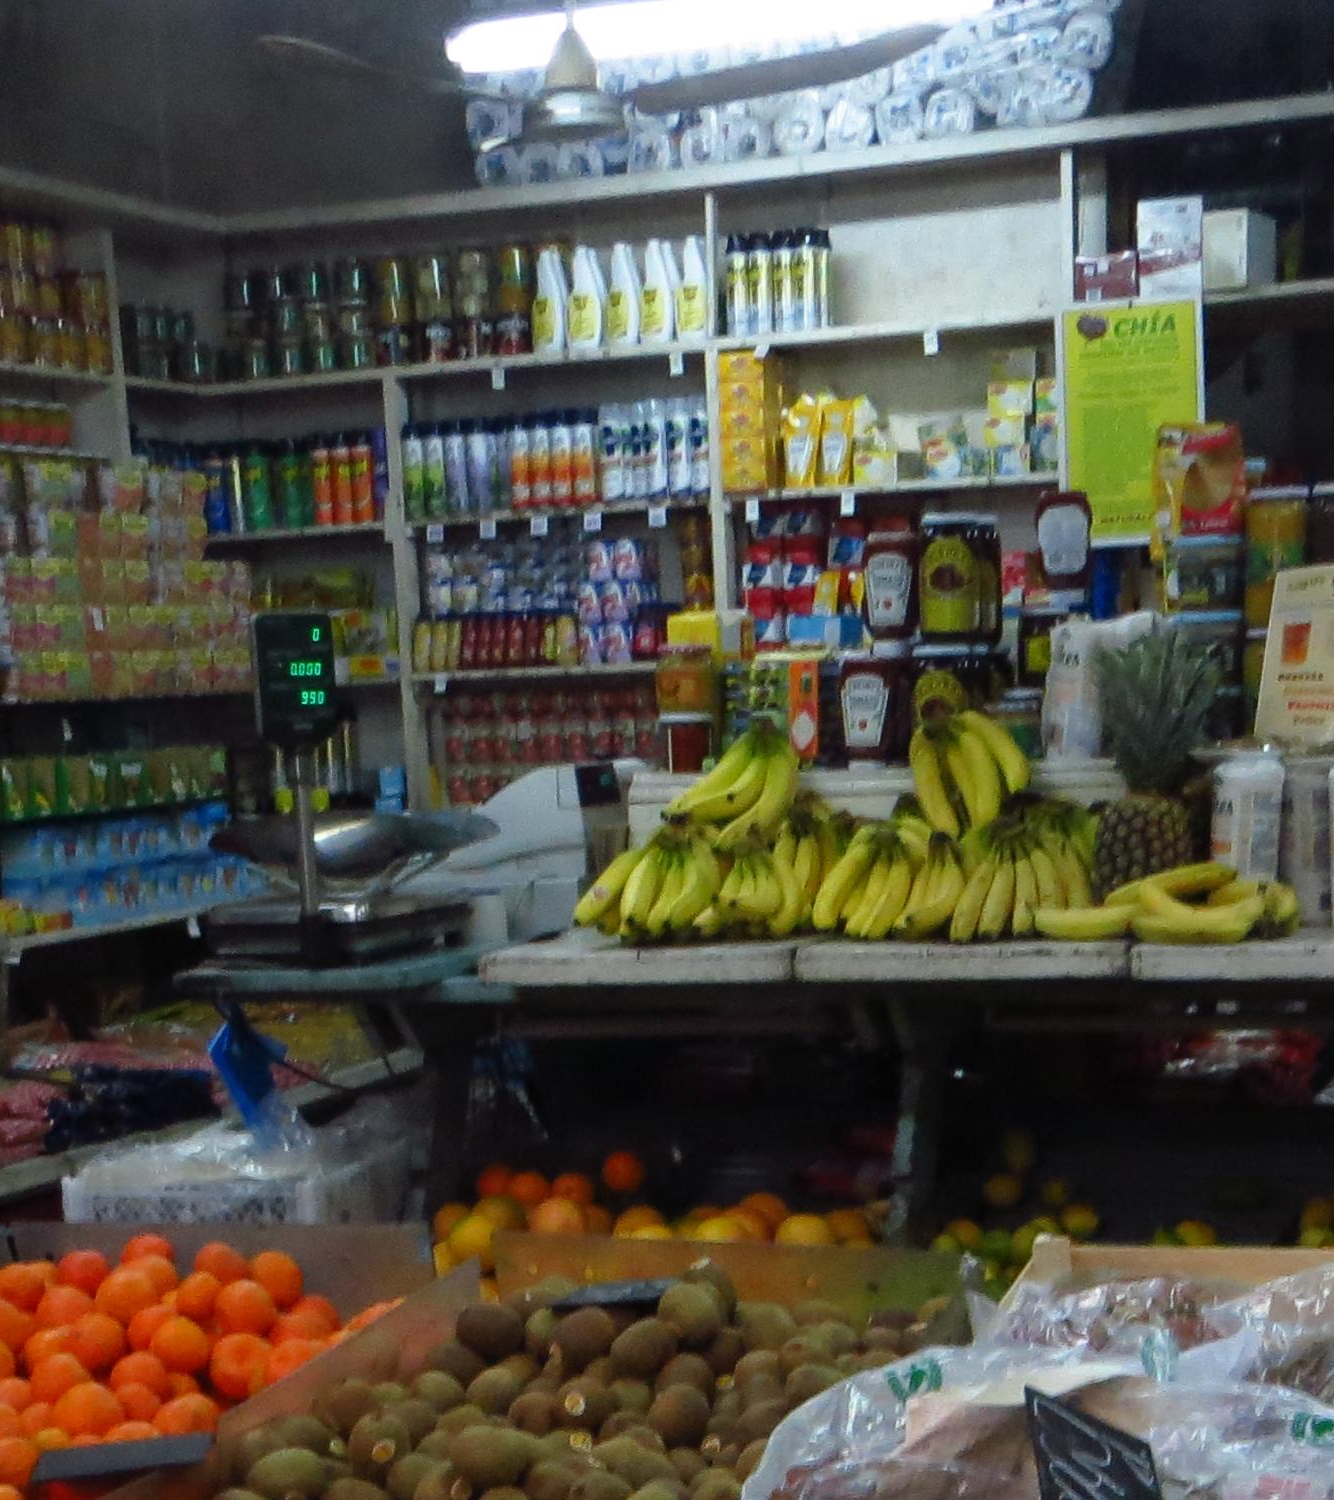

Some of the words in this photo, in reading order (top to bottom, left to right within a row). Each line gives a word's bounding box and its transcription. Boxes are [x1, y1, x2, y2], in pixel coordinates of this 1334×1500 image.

[1113, 309, 1176, 337] CHÍA
[312, 627, 320, 642] 0
[301, 691, 325, 705] 990
